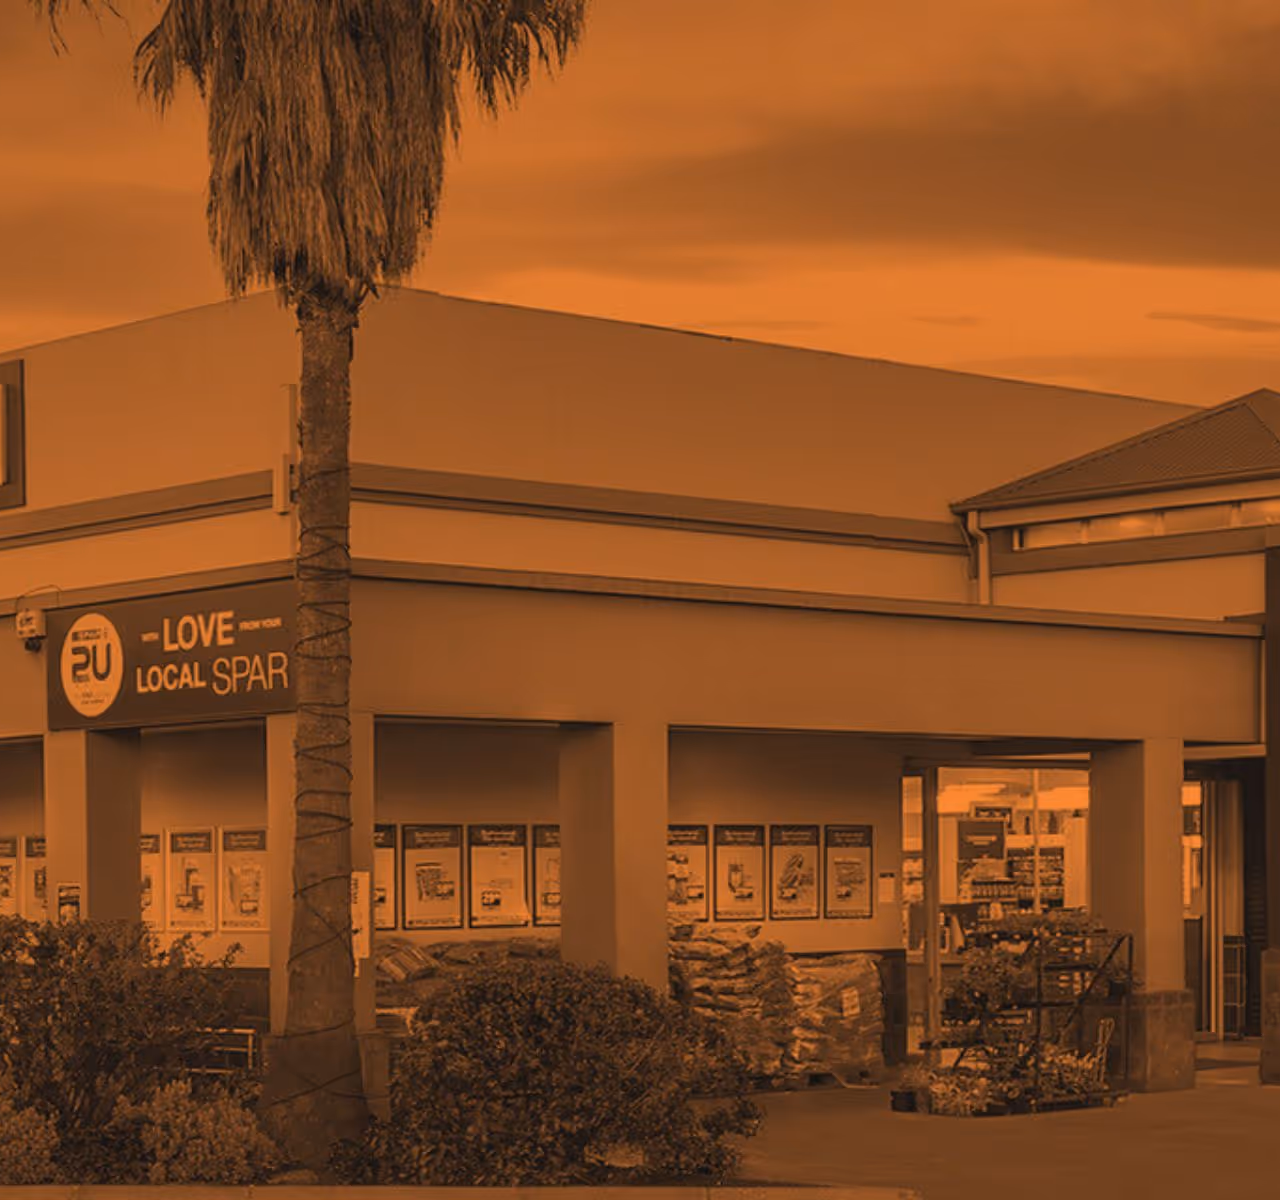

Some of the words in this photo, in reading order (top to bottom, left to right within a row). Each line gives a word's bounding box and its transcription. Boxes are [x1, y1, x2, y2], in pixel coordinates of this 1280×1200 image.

[163, 610, 234, 651] LOVE
[136, 661, 206, 693] LOCAL
[212, 652, 288, 695] SPAR
